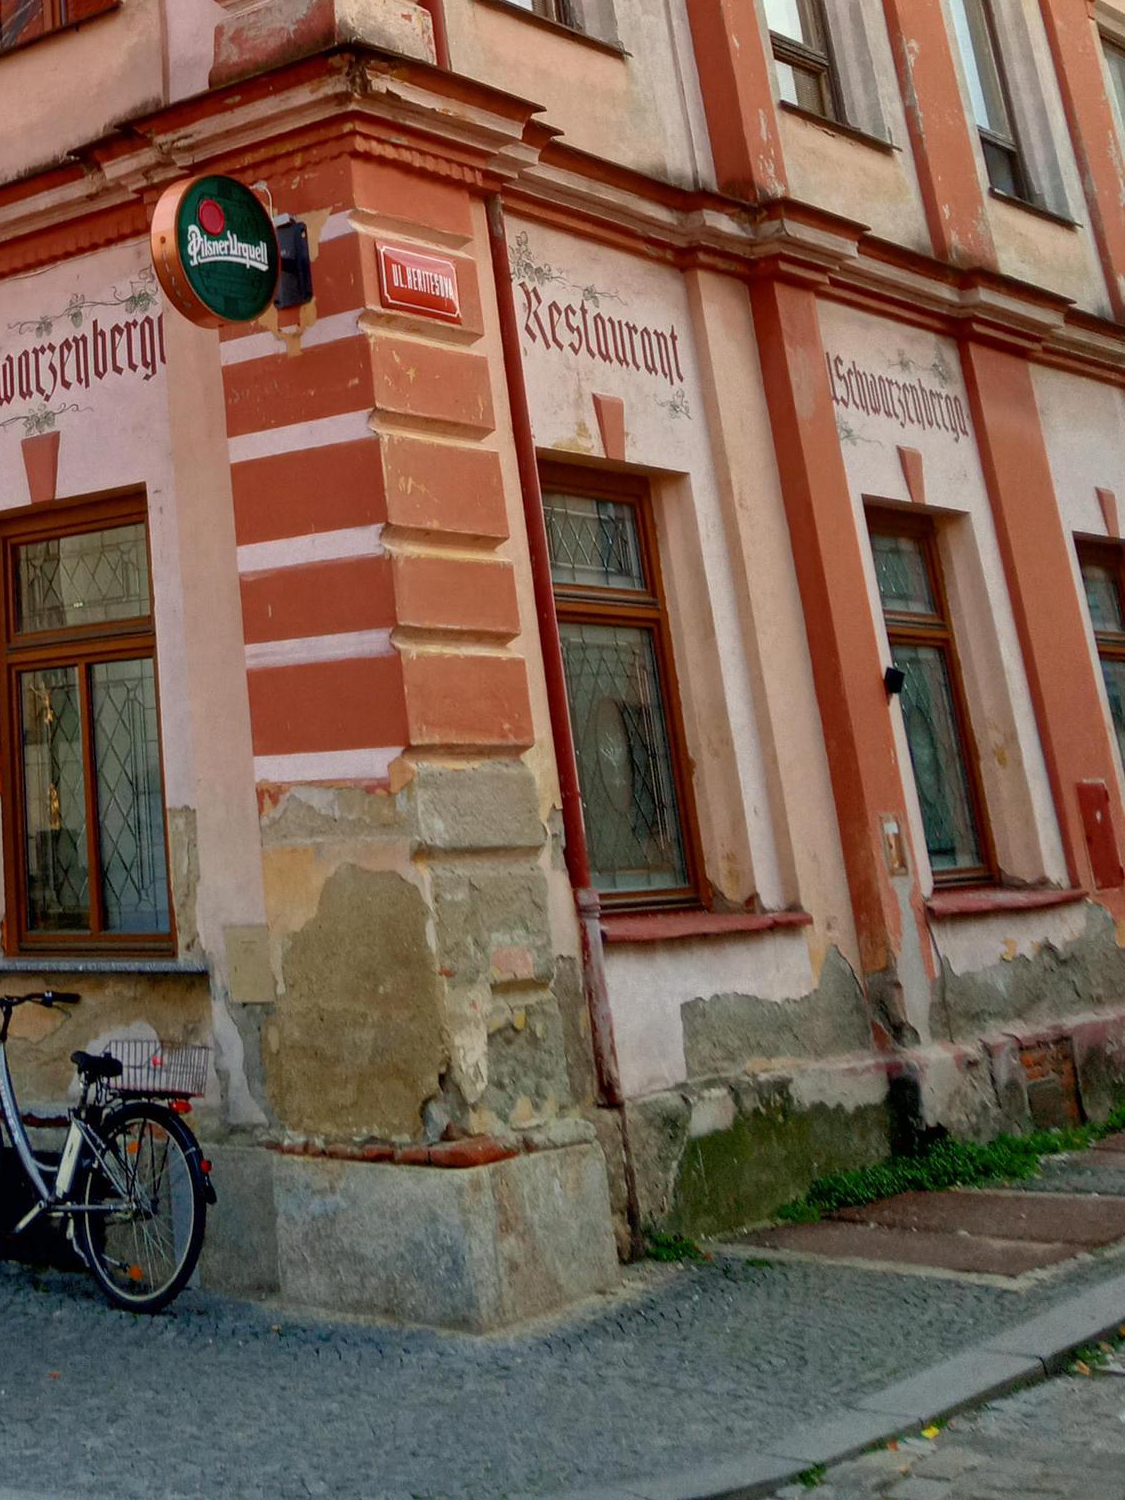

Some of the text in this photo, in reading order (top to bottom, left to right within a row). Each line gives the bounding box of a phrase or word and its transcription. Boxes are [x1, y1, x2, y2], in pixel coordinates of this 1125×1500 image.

[187, 224, 268, 269] Pilsner Urquell
[518, 282, 684, 386] Restaurant
